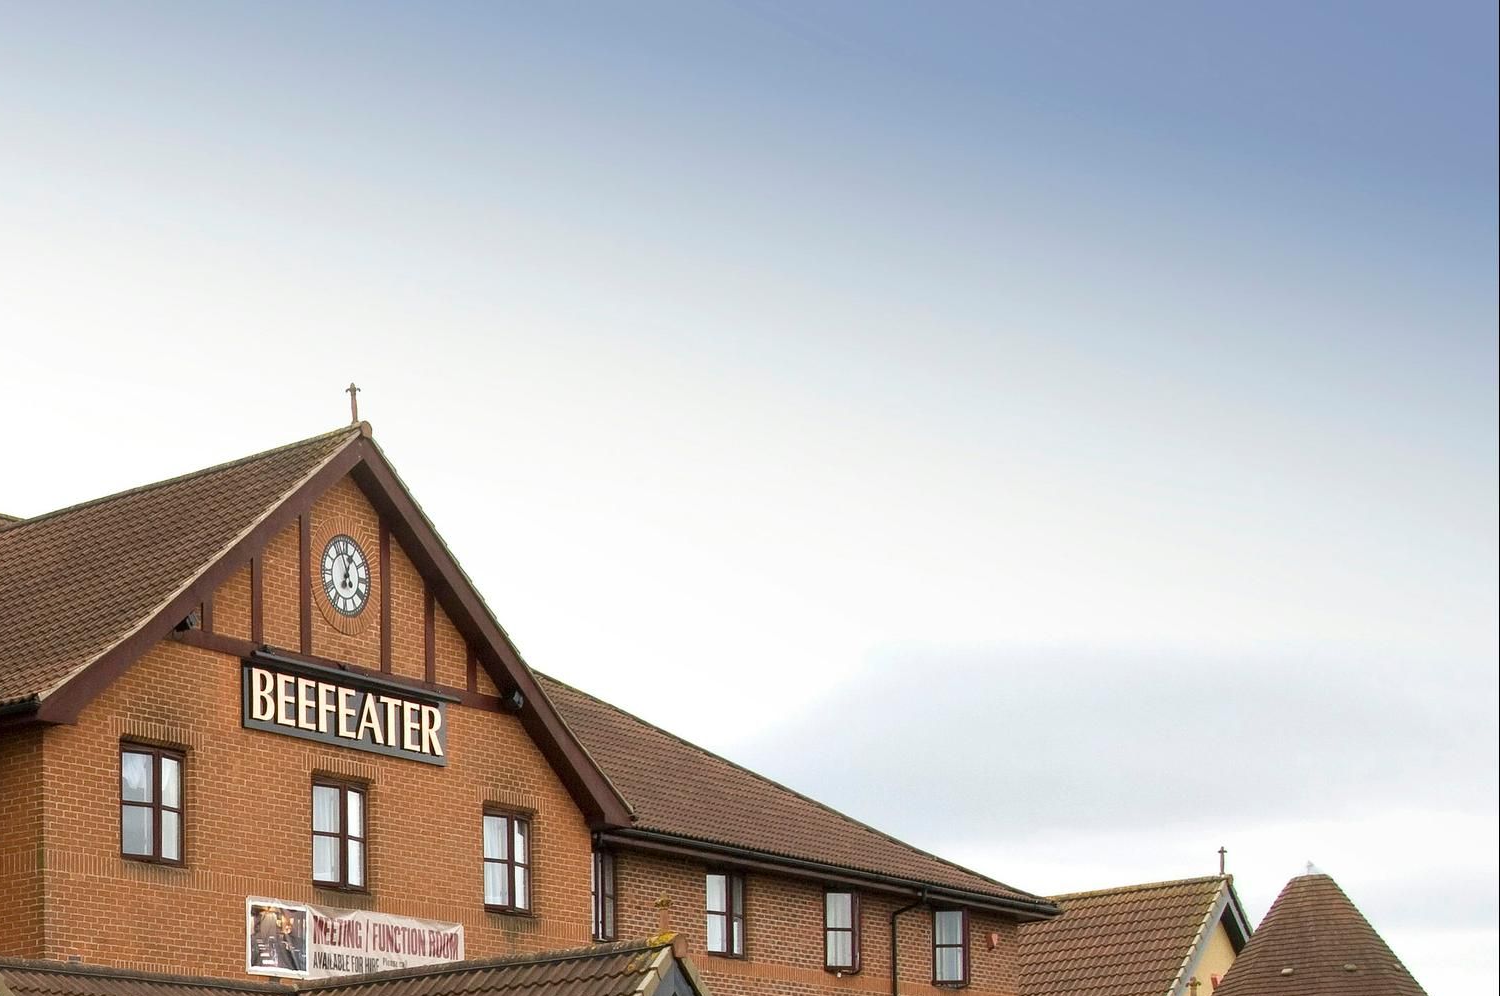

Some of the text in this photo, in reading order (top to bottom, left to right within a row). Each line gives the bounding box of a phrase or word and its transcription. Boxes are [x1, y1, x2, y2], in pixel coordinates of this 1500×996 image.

[251, 667, 444, 756] BEEFEATER
[313, 915, 362, 949] MEETING
[372, 923, 426, 957] FUNCTION
[428, 929, 459, 960] ROOM
[313, 951, 350, 972] AVAILABLE
[351, 955, 364, 974] FOR
